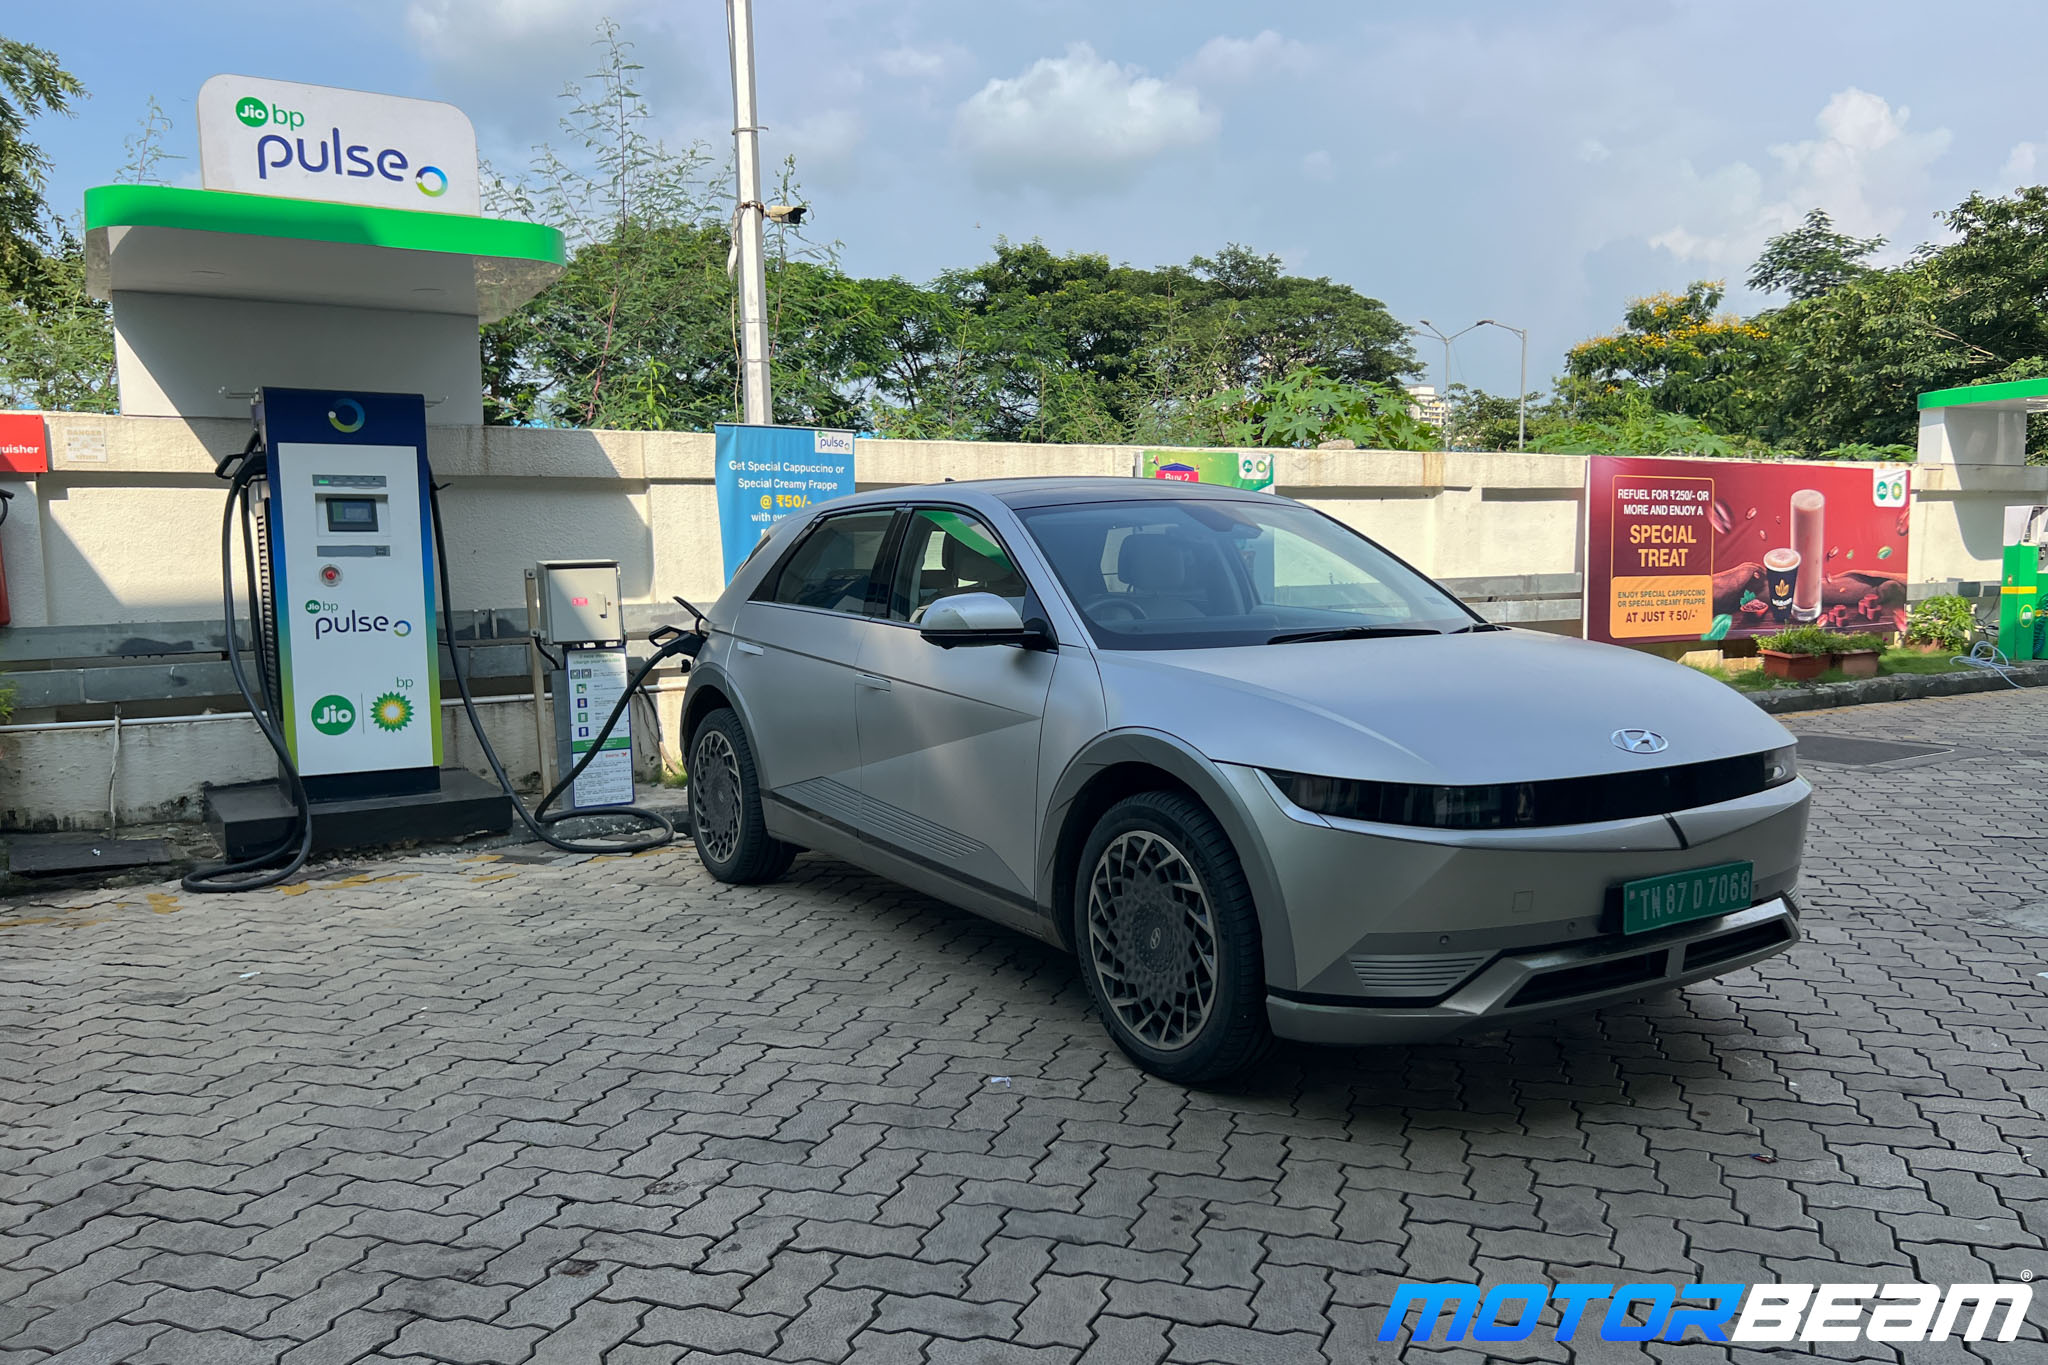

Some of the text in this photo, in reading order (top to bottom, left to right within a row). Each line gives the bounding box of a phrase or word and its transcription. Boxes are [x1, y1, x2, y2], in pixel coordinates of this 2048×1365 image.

[239, 104, 305, 131] Jio bp
[257, 127, 409, 182] pulse
[0, 444, 40, 454] uisher
[820, 437, 844, 449] pulse
[728, 461, 746, 471] Get
[747, 461, 780, 473] Special
[783, 462, 834, 474] Cappuccino
[738, 478, 838, 492] Special Creamy Frappe
[760, 495, 812, 509] @ ₹50/-
[1617, 488, 1650, 500] REFUEL
[1651, 489, 1669, 500] FOR
[1696, 491, 1709, 502] OR
[751, 512, 771, 522] with
[1623, 504, 1703, 516] MORE AND ENJOY A
[1629, 524, 1697, 544] SPECIAL
[1638, 548, 1688, 567] TREAT
[1617, 588, 1706, 599] ENJOY SPECIAL CAPPUCCINO
[322, 601, 338, 613] bp
[1628, 600, 1655, 608] SPECIAL
[1656, 599, 1681, 607] CREAMY
[1682, 598, 1706, 606] FRAPPE
[1625, 612, 1638, 623] AT
[1640, 611, 1665, 622] JUST
[315, 609, 389, 640] pulse
[396, 676, 413, 690] bp
[316, 704, 352, 724] Jio
[1640, 886, 1661, 920] TN
[1666, 883, 1687, 914] 87
[1708, 870, 1750, 907] 7068
